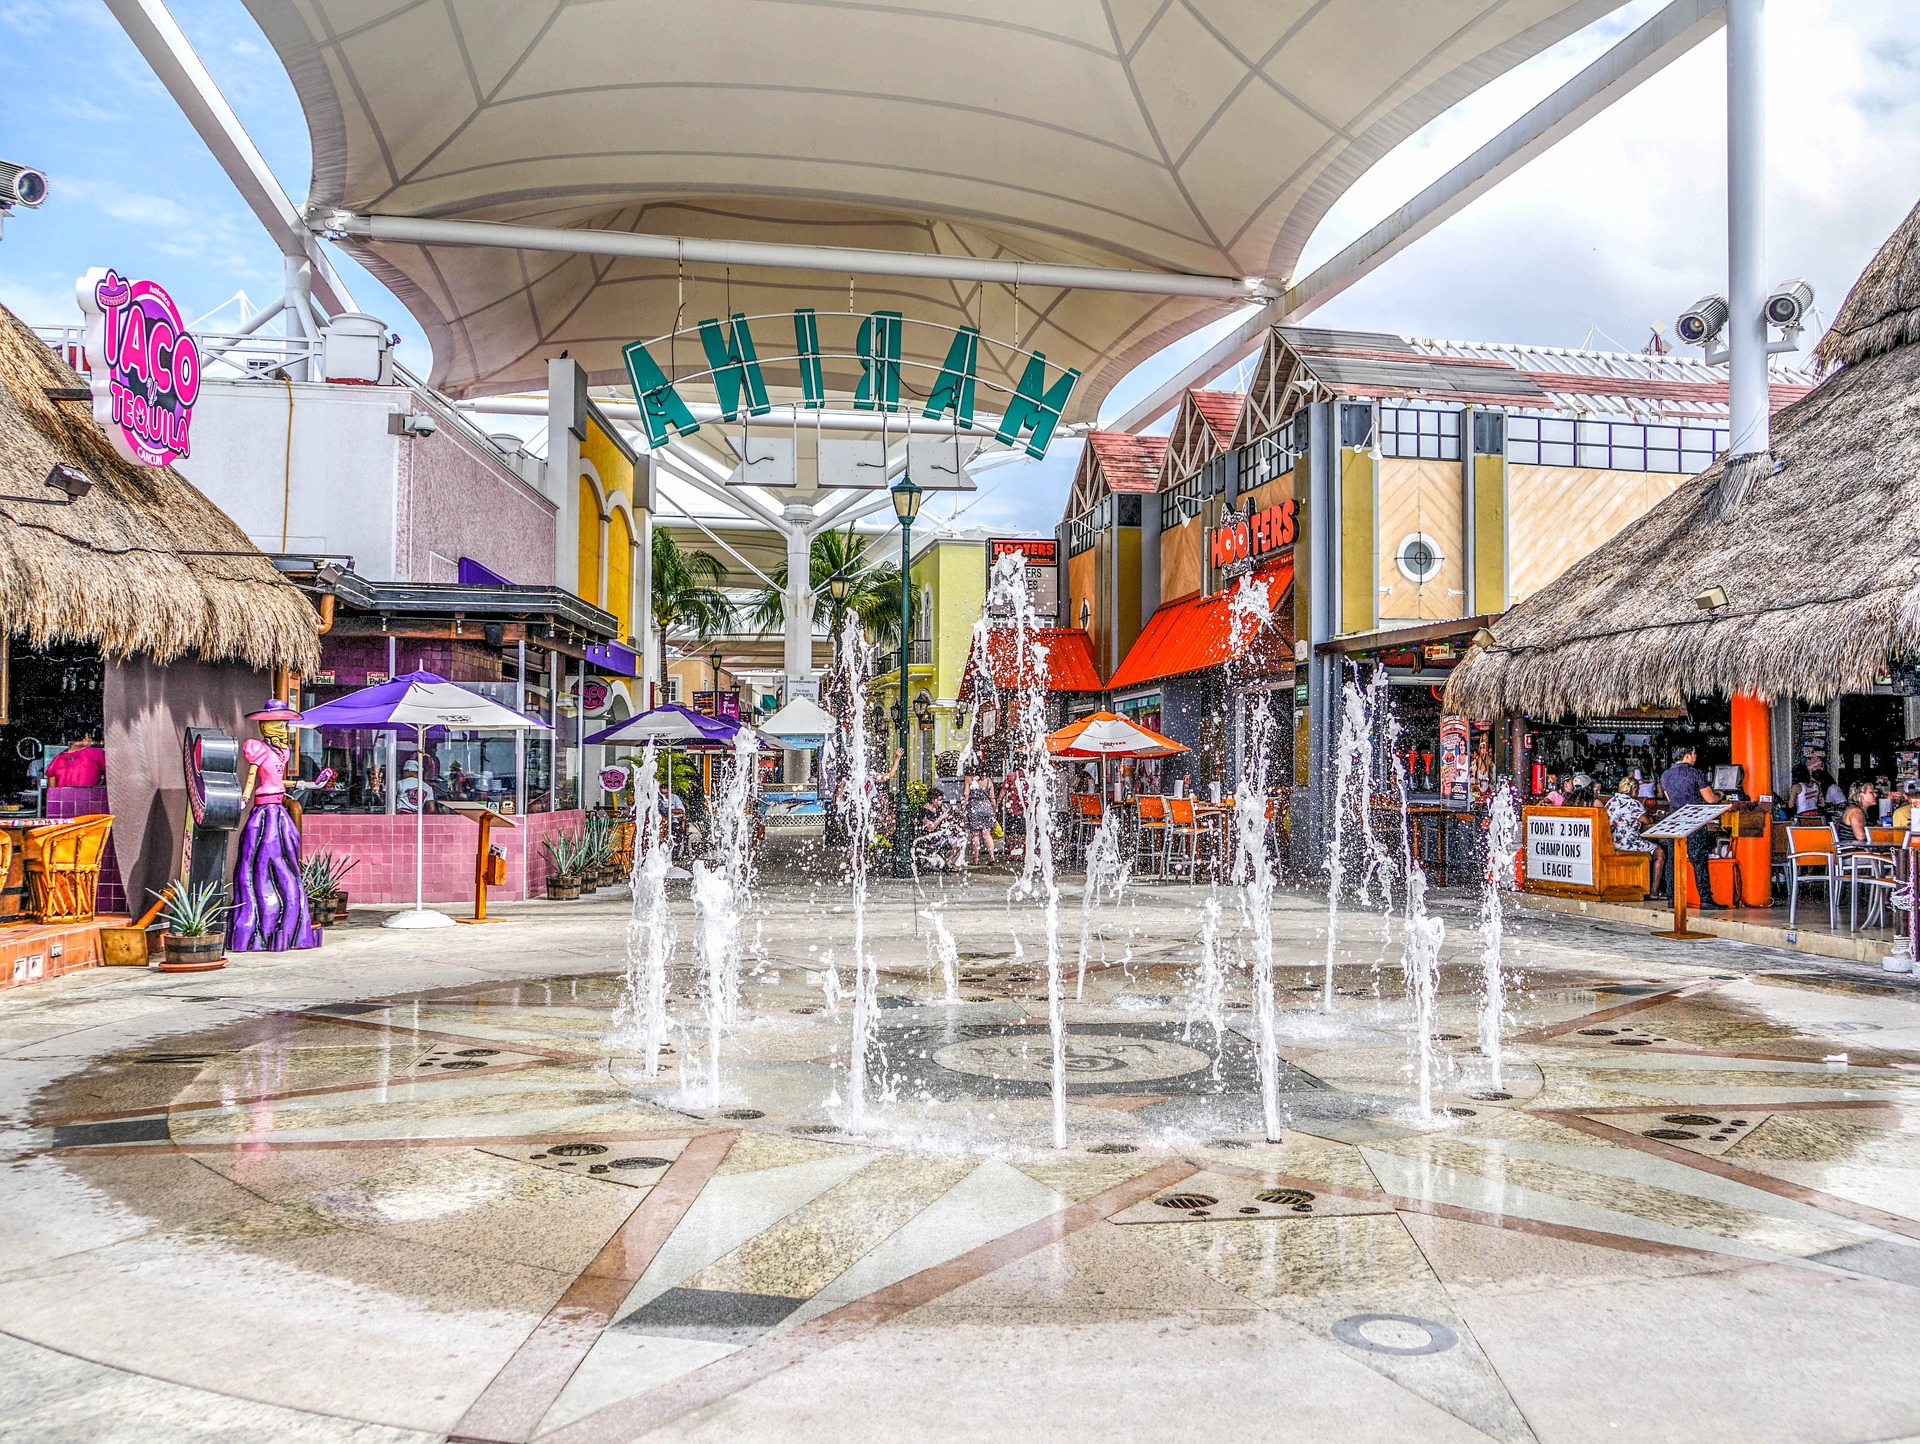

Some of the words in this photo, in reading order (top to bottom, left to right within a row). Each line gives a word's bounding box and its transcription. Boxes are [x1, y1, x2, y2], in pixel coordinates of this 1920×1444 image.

[100, 285, 200, 408] TACO
[111, 381, 190, 458] TEQUILA
[1211, 499, 1297, 569] HOOTERS
[1530, 822, 1555, 836] TODAY
[1560, 824, 1565, 836] 2
[1568, 824, 1590, 838] 30PM
[1535, 842, 1581, 858] CHAMPIONS
[1542, 862, 1572, 878] LEAGUE
